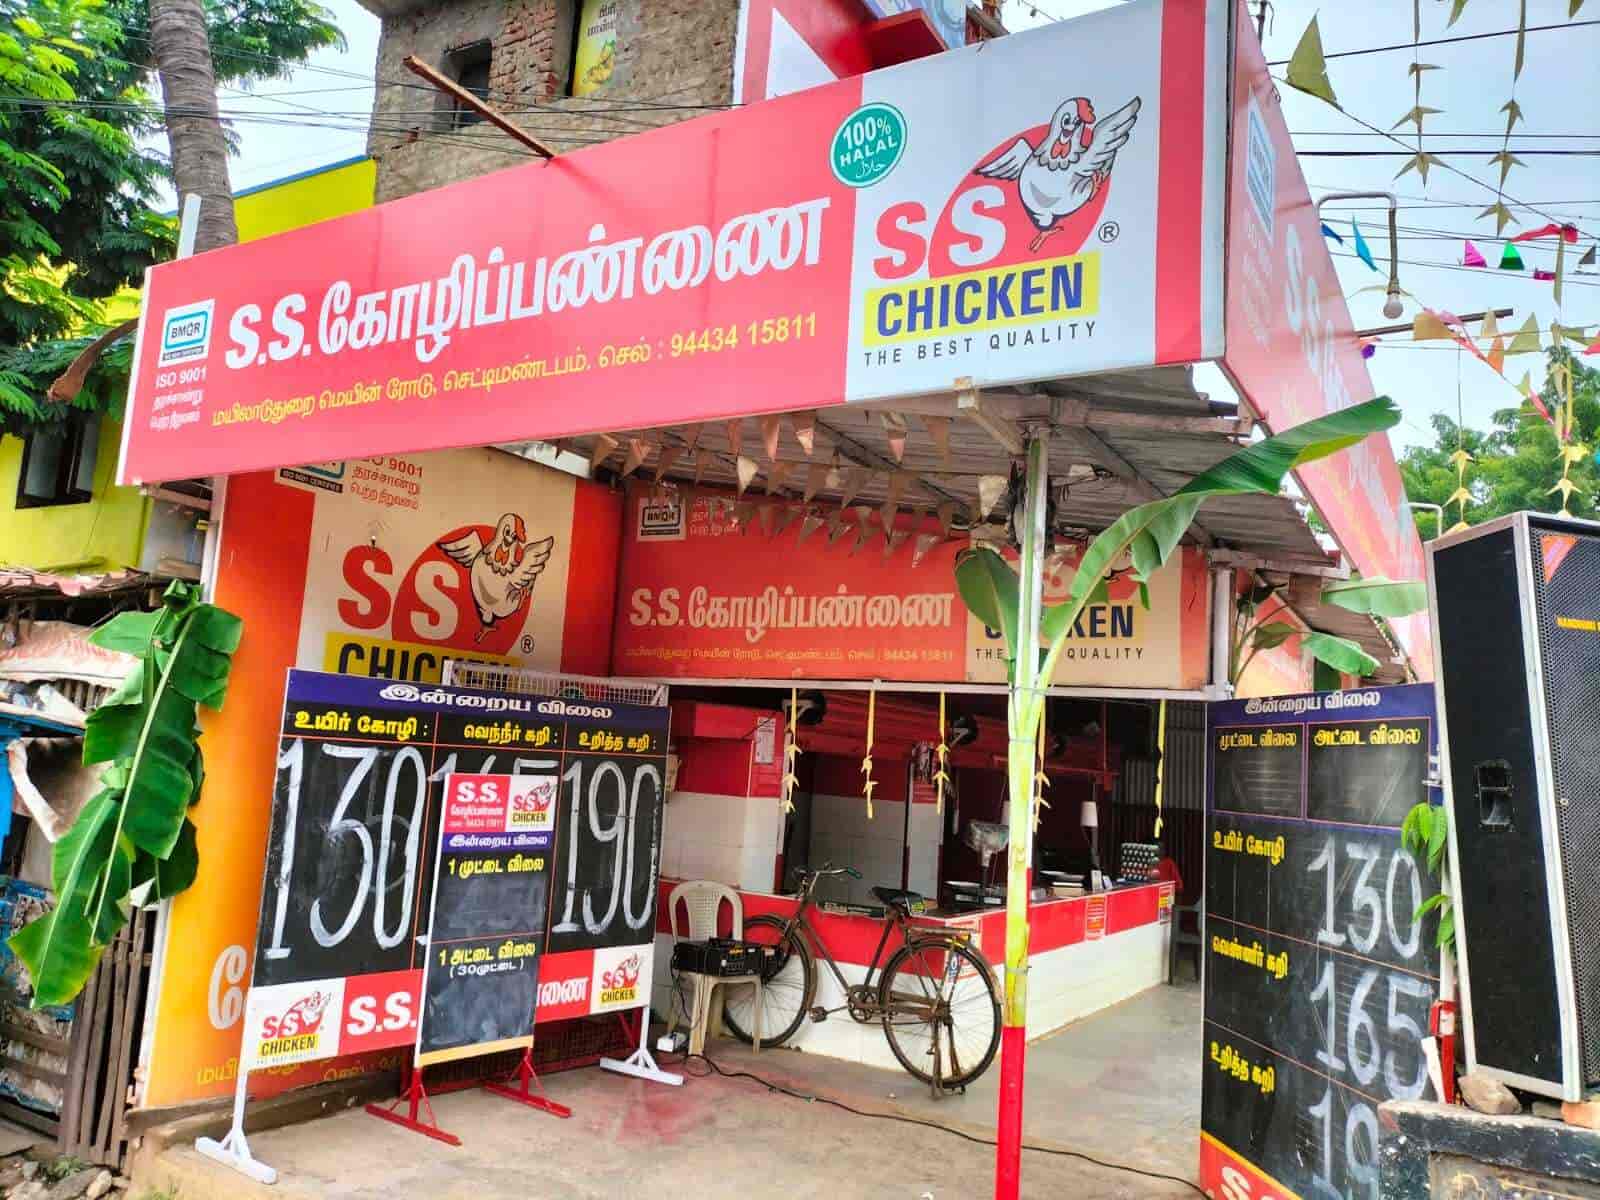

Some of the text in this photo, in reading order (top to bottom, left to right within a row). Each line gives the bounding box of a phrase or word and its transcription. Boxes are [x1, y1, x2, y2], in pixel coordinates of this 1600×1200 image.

[842, 116, 892, 149] 100%
[839, 135, 898, 168] HALAL
[876, 261, 1084, 337] CHICKEN
[864, 320, 1096, 367] THE BEST QUALITY
[318, 379, 382, 411] மெயின்
[598, 335, 651, 369] செல்
[670, 324, 738, 359] 94434
[747, 312, 817, 346] 15811
[155, 365, 208, 390] ISO 9001
[388, 457, 424, 479] 9001
[1066, 647, 1145, 660] QUALITY
[379, 682, 613, 719] இன்றைய விலை
[1244, 690, 1381, 716] இன்றைய விலை
[294, 710, 352, 732] உயிர்
[356, 715, 418, 741] கோழி
[524, 726, 551, 747] கறி
[1313, 723, 1421, 747] அட்டை விலை
[626, 733, 650, 752] கறி
[1219, 728, 1297, 751] முட்டை விலை
[456, 781, 502, 803] S.S.
[512, 812, 546, 824] CHICKEN
[263, 736, 428, 960] 130
[449, 834, 548, 849] இன்றைய விலை
[551, 760, 662, 935] 190
[1213, 830, 1286, 865] உயிர் கோழி
[448, 853, 545, 880] 1 முட்டை விலை
[1307, 835, 1423, 959] 130
[438, 940, 536, 966] 1 அட்டை விலை
[1266, 951, 1288, 979] கறி
[601, 989, 636, 1004] CHICKEN
[347, 991, 418, 1036] S.S.
[1309, 960, 1434, 1104] 165
[261, 1035, 317, 1057] CHICKEN
[1251, 1065, 1275, 1094] கறி
